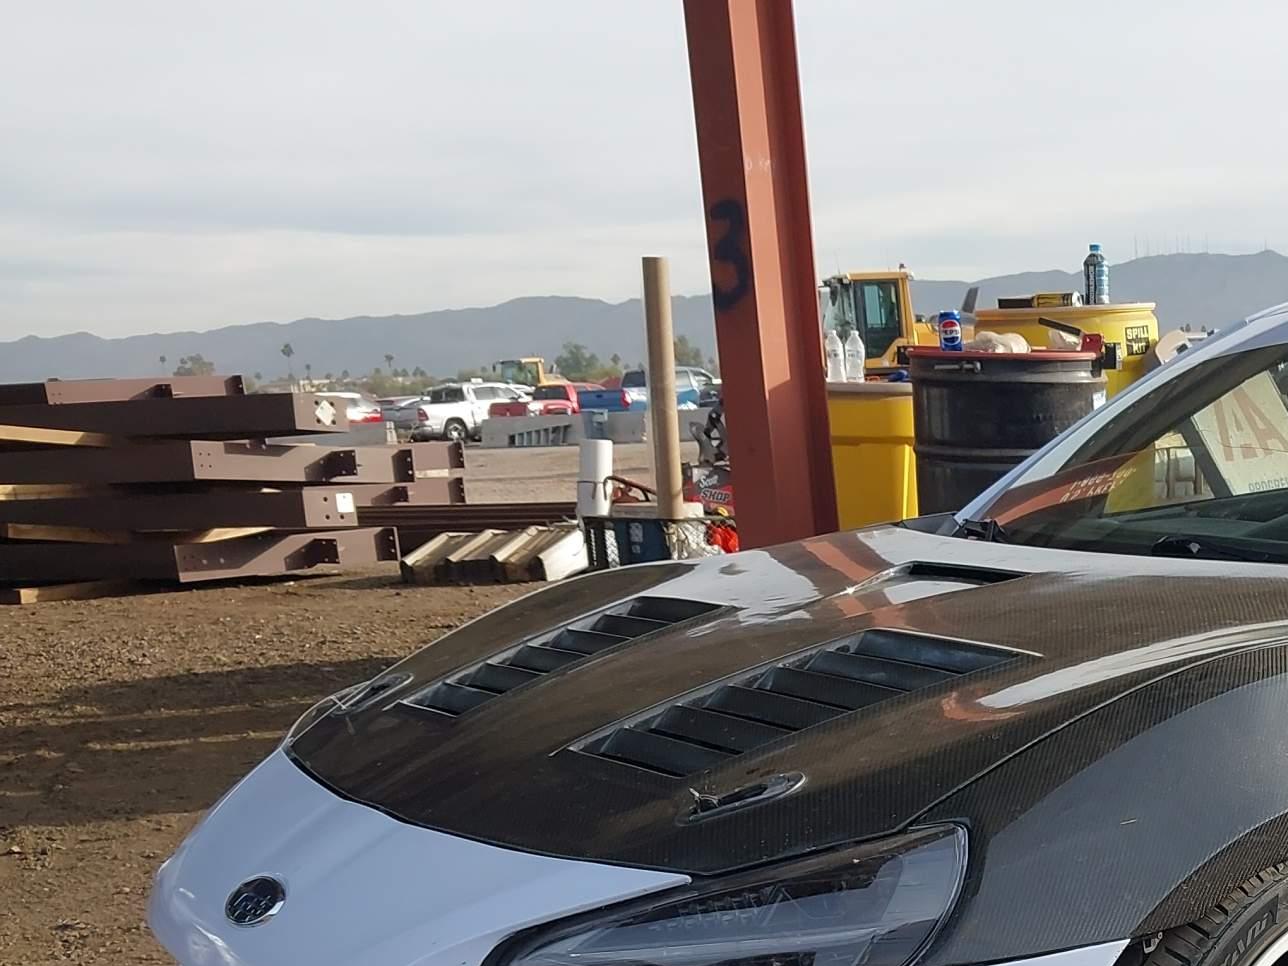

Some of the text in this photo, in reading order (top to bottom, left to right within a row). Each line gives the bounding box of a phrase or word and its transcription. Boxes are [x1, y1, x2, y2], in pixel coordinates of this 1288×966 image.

[710, 197, 749, 311] 3
[1126, 325, 1149, 340] SPILL
[1132, 342, 1147, 354] KIT
[701, 489, 730, 501] SHOP
